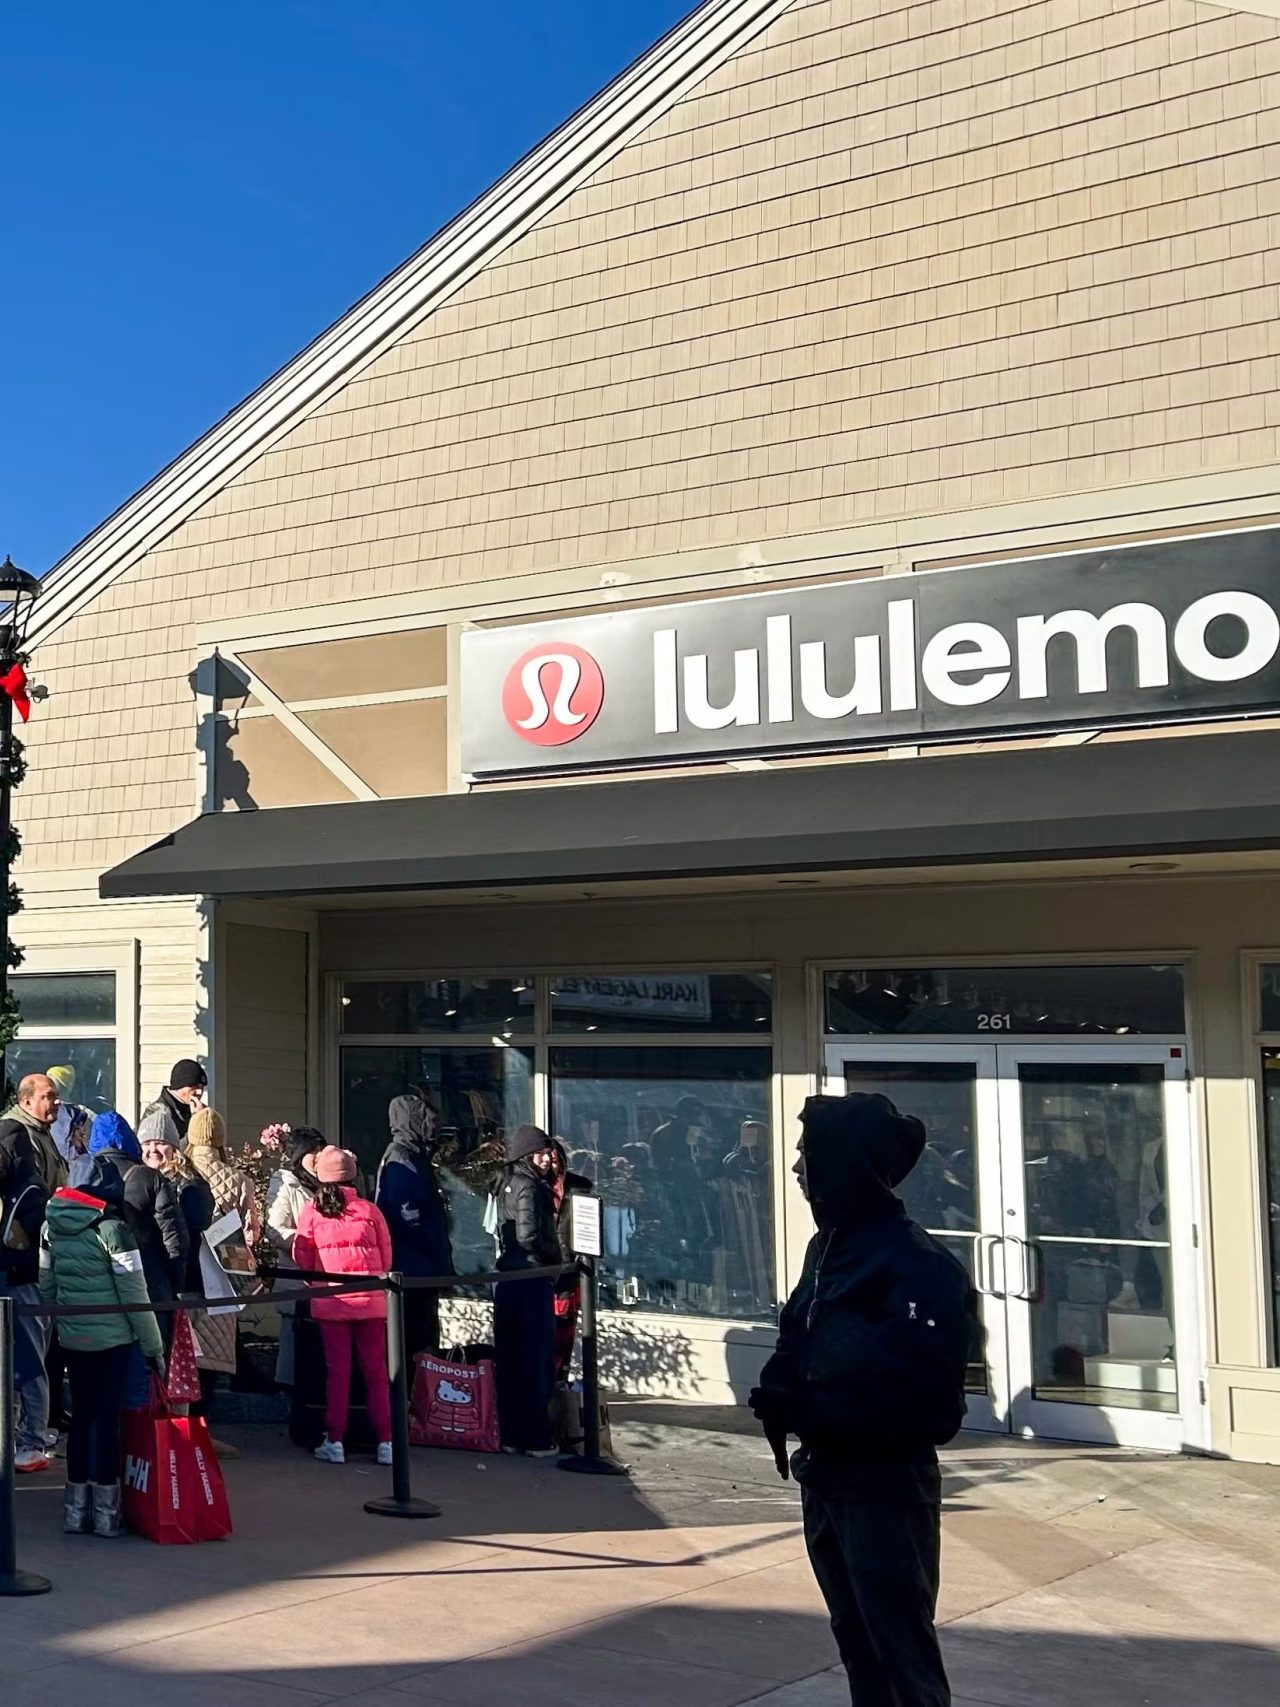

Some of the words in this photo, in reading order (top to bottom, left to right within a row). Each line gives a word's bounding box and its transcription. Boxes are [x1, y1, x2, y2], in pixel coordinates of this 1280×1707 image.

[977, 1014, 1011, 1029] 261
[421, 1360, 485, 1379] AEROPOSTE
[169, 1449, 177, 1474] HELLY
[194, 1446, 206, 1471] HELLY
[125, 1454, 149, 1494] HH
[171, 1476, 180, 1509] HANSEN
